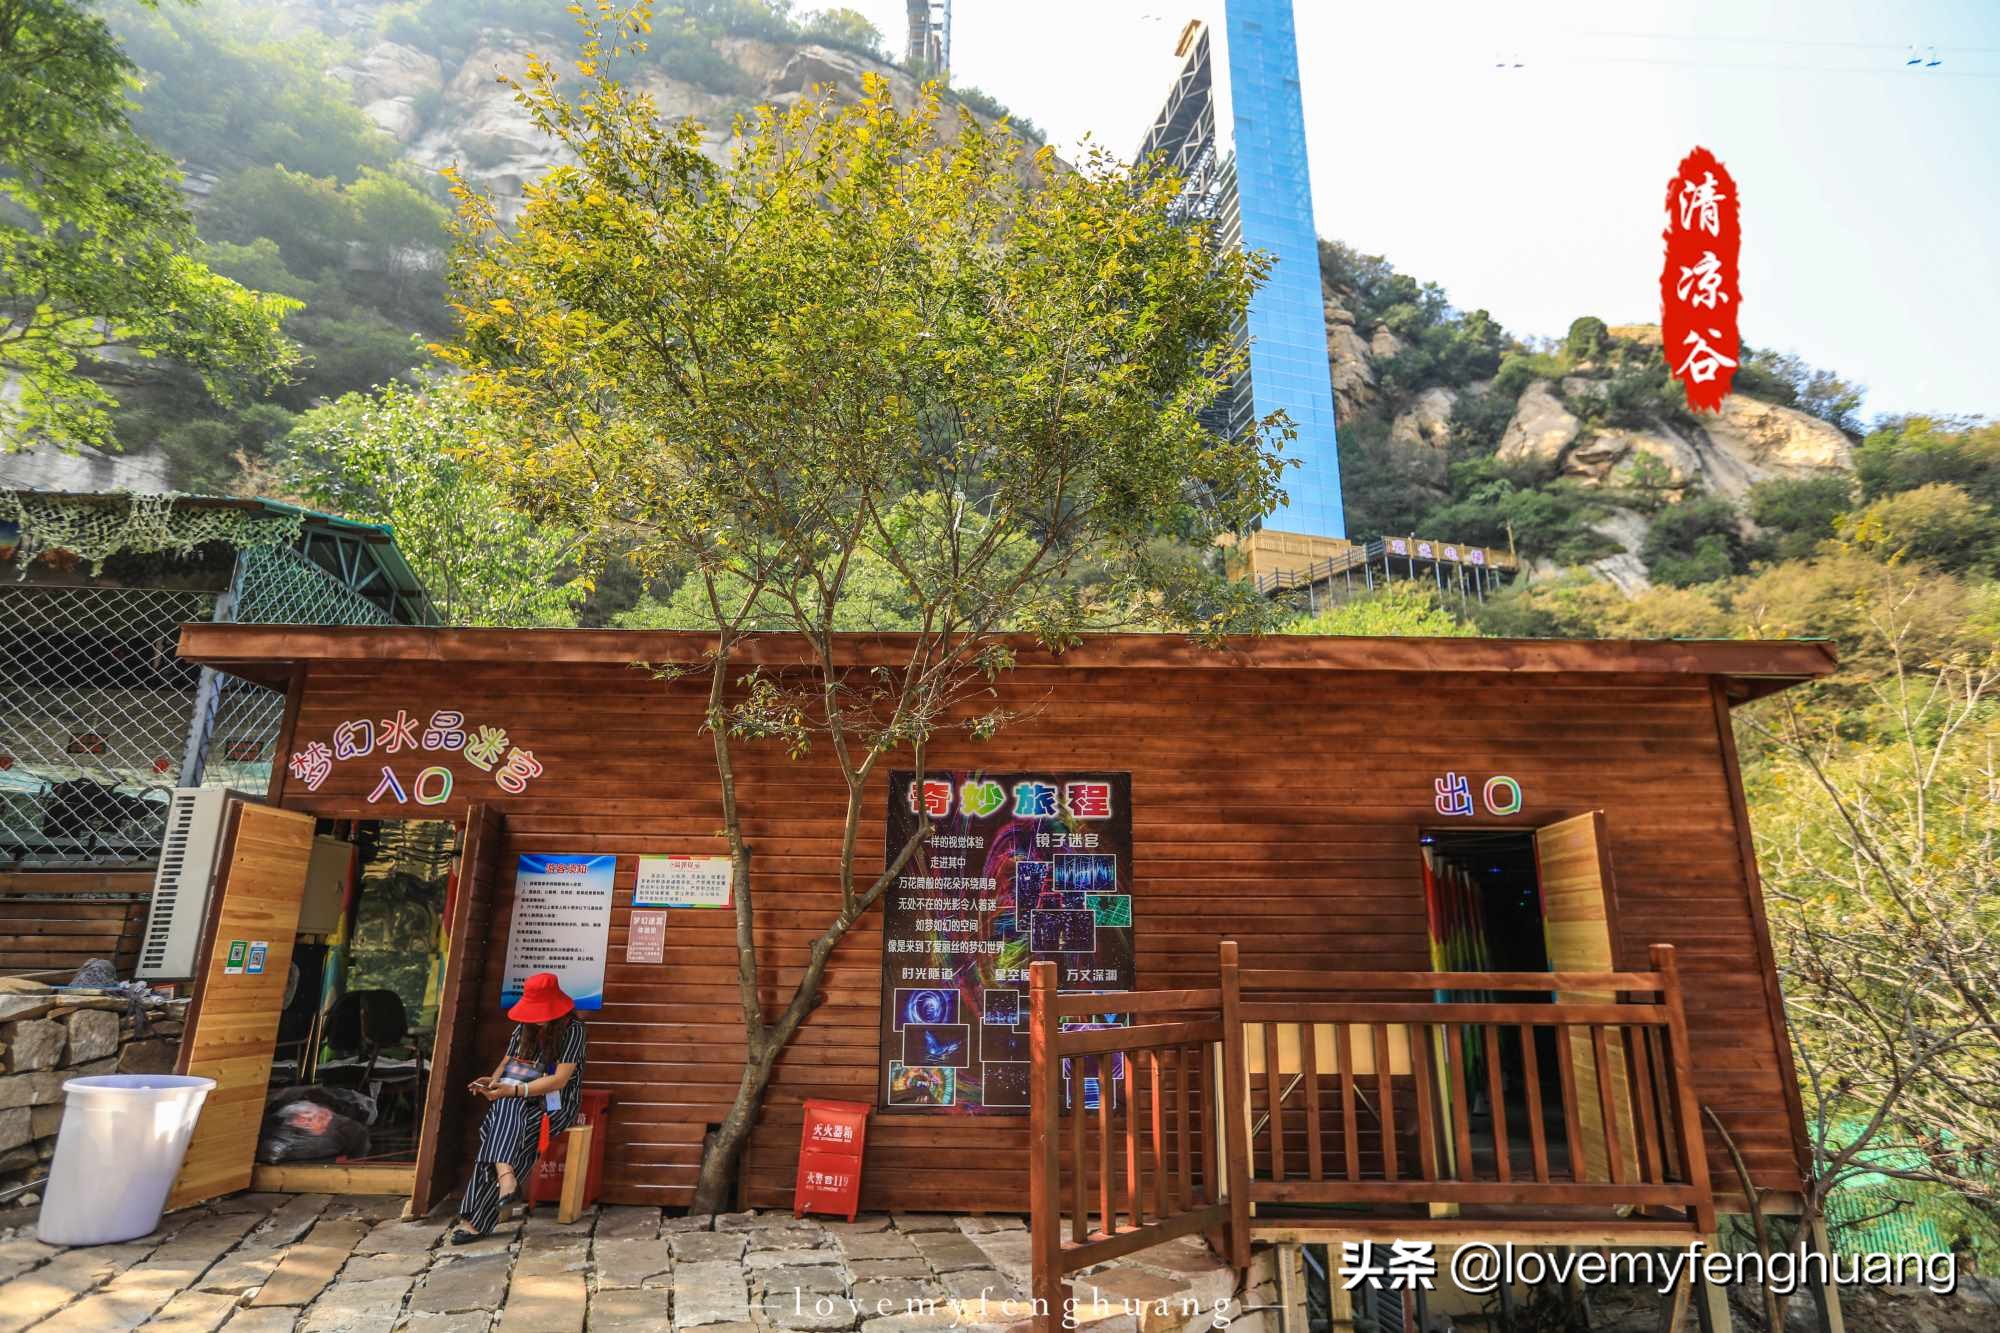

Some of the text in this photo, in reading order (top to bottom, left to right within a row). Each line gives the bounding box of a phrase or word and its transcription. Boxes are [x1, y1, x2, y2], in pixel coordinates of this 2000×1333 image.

[288, 709, 544, 794] 梦幻水晶迷宫
[367, 766, 454, 805] 入口
[909, 781, 1112, 818] 奇妙旅程
[1434, 772, 1522, 816] 出口
[924, 836, 984, 849] 一样的视觉体验
[1035, 833, 1099, 848] 镜子迷宫
[930, 856, 967, 869] 走进其中
[898, 876, 997, 890] 万花筒般的花朵环绕周身
[897, 897, 997, 912] 无处不在的光影令人着迷
[915, 919, 979, 932] 如梦如幻的空间
[888, 940, 1005, 953] 像是来到了爱丽丝的梦幻世界
[902, 967, 953, 980] 时光隧道
[1066, 968, 1118, 982] 万丈深渊
[813, 1123, 853, 1139] 灭火器箱
